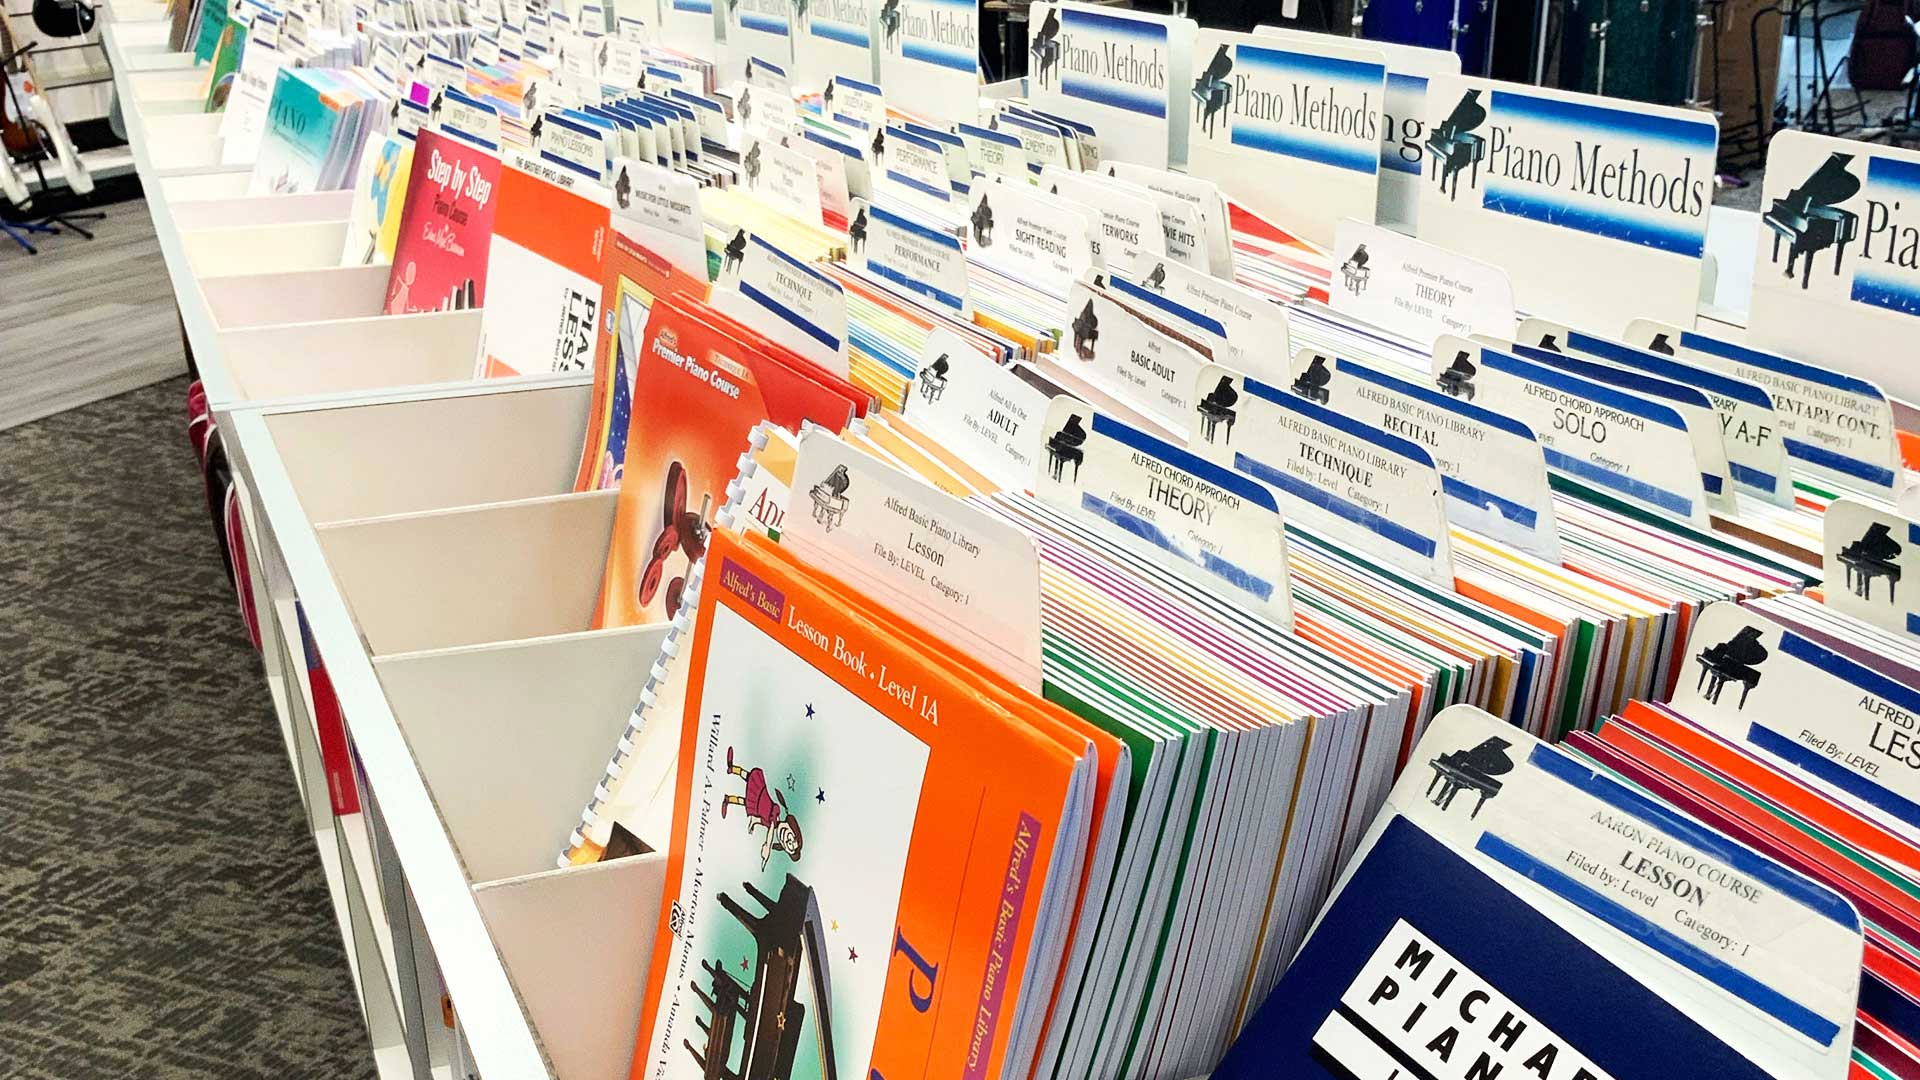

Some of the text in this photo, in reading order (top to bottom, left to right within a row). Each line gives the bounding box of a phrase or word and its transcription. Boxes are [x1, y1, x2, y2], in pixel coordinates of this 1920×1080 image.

[901, 4, 976, 50] Piano Methods
[1062, 33, 1165, 91] Piano Methods
[1233, 74, 1377, 142] Piano Methods
[427, 148, 493, 211] Step by Step
[896, 147, 939, 175] PERFORMANCE
[979, 147, 1004, 166] THEORY
[1486, 126, 1705, 218] Piano Methods
[894, 243, 941, 273] PERFORMANCE
[1178, 230, 1195, 248] HITS
[775, 271, 813, 301] TECHNIQUE
[1415, 282, 1456, 309] THEORY
[652, 337, 741, 400] Premier Piano Course
[1129, 349, 1177, 383] BASIC ADULT
[989, 388, 1005, 406] Alfred
[1004, 397, 1012, 411] All
[1017, 408, 1028, 421] One
[1355, 386, 1486, 443] ALFRED BASIC PIANO LIBRARY
[1522, 382, 1645, 433] ALFRED CHORD APPROACH
[1735, 366, 1881, 418] ALFRED BASIC PIANO LIBRARY
[962, 413, 973, 427] File
[980, 424, 999, 444] LEVEL
[985, 407, 1020, 438] ADULT
[1277, 414, 1409, 480] ALFRED BASIC PIANO LIBRARY
[1382, 412, 1440, 448] RECITAL
[1552, 407, 1607, 445] SOLO
[1720, 412, 1773, 447] Y A-F
[1836, 413, 1882, 441] CONT.
[1130, 451, 1241, 511] ALFRED CHORD APPROACH
[1286, 457, 1305, 476] Filed
[1304, 465, 1318, 482] by:
[1317, 470, 1338, 492] Level
[1347, 485, 1384, 514] Category:
[1298, 441, 1374, 489] TECHNIQUE
[1589, 451, 1624, 474] Category:
[1109, 491, 1126, 507] Filed
[1125, 497, 1136, 511] By:
[1135, 502, 1157, 522] LEVEL
[1186, 528, 1219, 554] Category:
[1145, 473, 1217, 527] THEORY
[882, 495, 983, 560] Alfred Basic Piano Library
[906, 531, 946, 569] Lesson
[722, 569, 782, 619] Alfred's Basic
[872, 541, 889, 560] File
[888, 549, 901, 569] By:
[899, 556, 927, 582] LEVEL
[929, 573, 966, 607] Category:
[786, 603, 940, 728] Lesson Book Level 1A
[1857, 694, 1915, 731] ALFRED
[1797, 728, 1880, 779] Filed By: LEVEL
[1868, 720, 1920, 771] LES
[1590, 809, 1763, 905] AARON PIANO COURSE
[1618, 848, 1712, 909] LESSON
[661, 712, 722, 1054] Willard A. Palmer Morton Manus Amanda
[1564, 849, 1751, 957] Filed by: Level Category: 1
[966, 819, 1033, 1073] Alfred's Basic Piano Library
[1393, 938, 1600, 1080] MICHA
